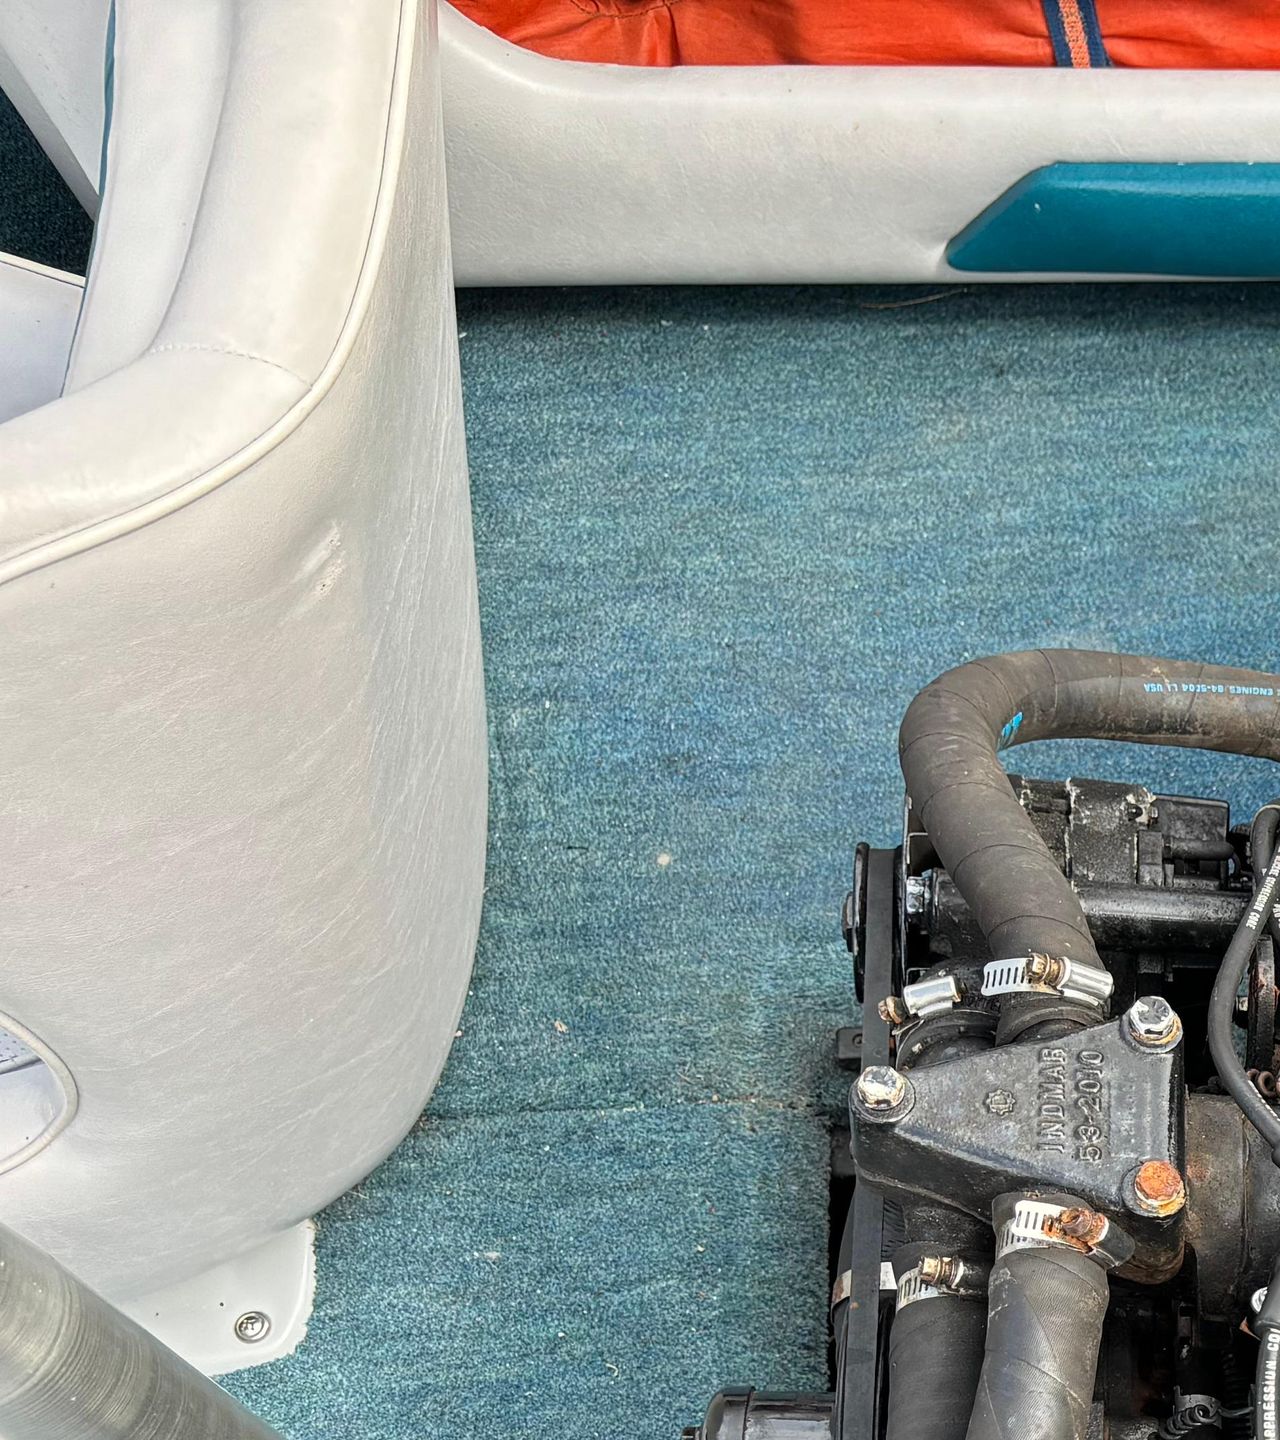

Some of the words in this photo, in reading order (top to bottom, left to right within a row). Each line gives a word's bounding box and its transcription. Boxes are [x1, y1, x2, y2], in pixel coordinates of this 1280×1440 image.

[1144, 683, 1162, 692] USA
[1246, 912, 1260, 929] CORE
[1036, 1047, 1067, 1155] INDMAR
[1074, 1049, 1104, 1163] 53-2010
